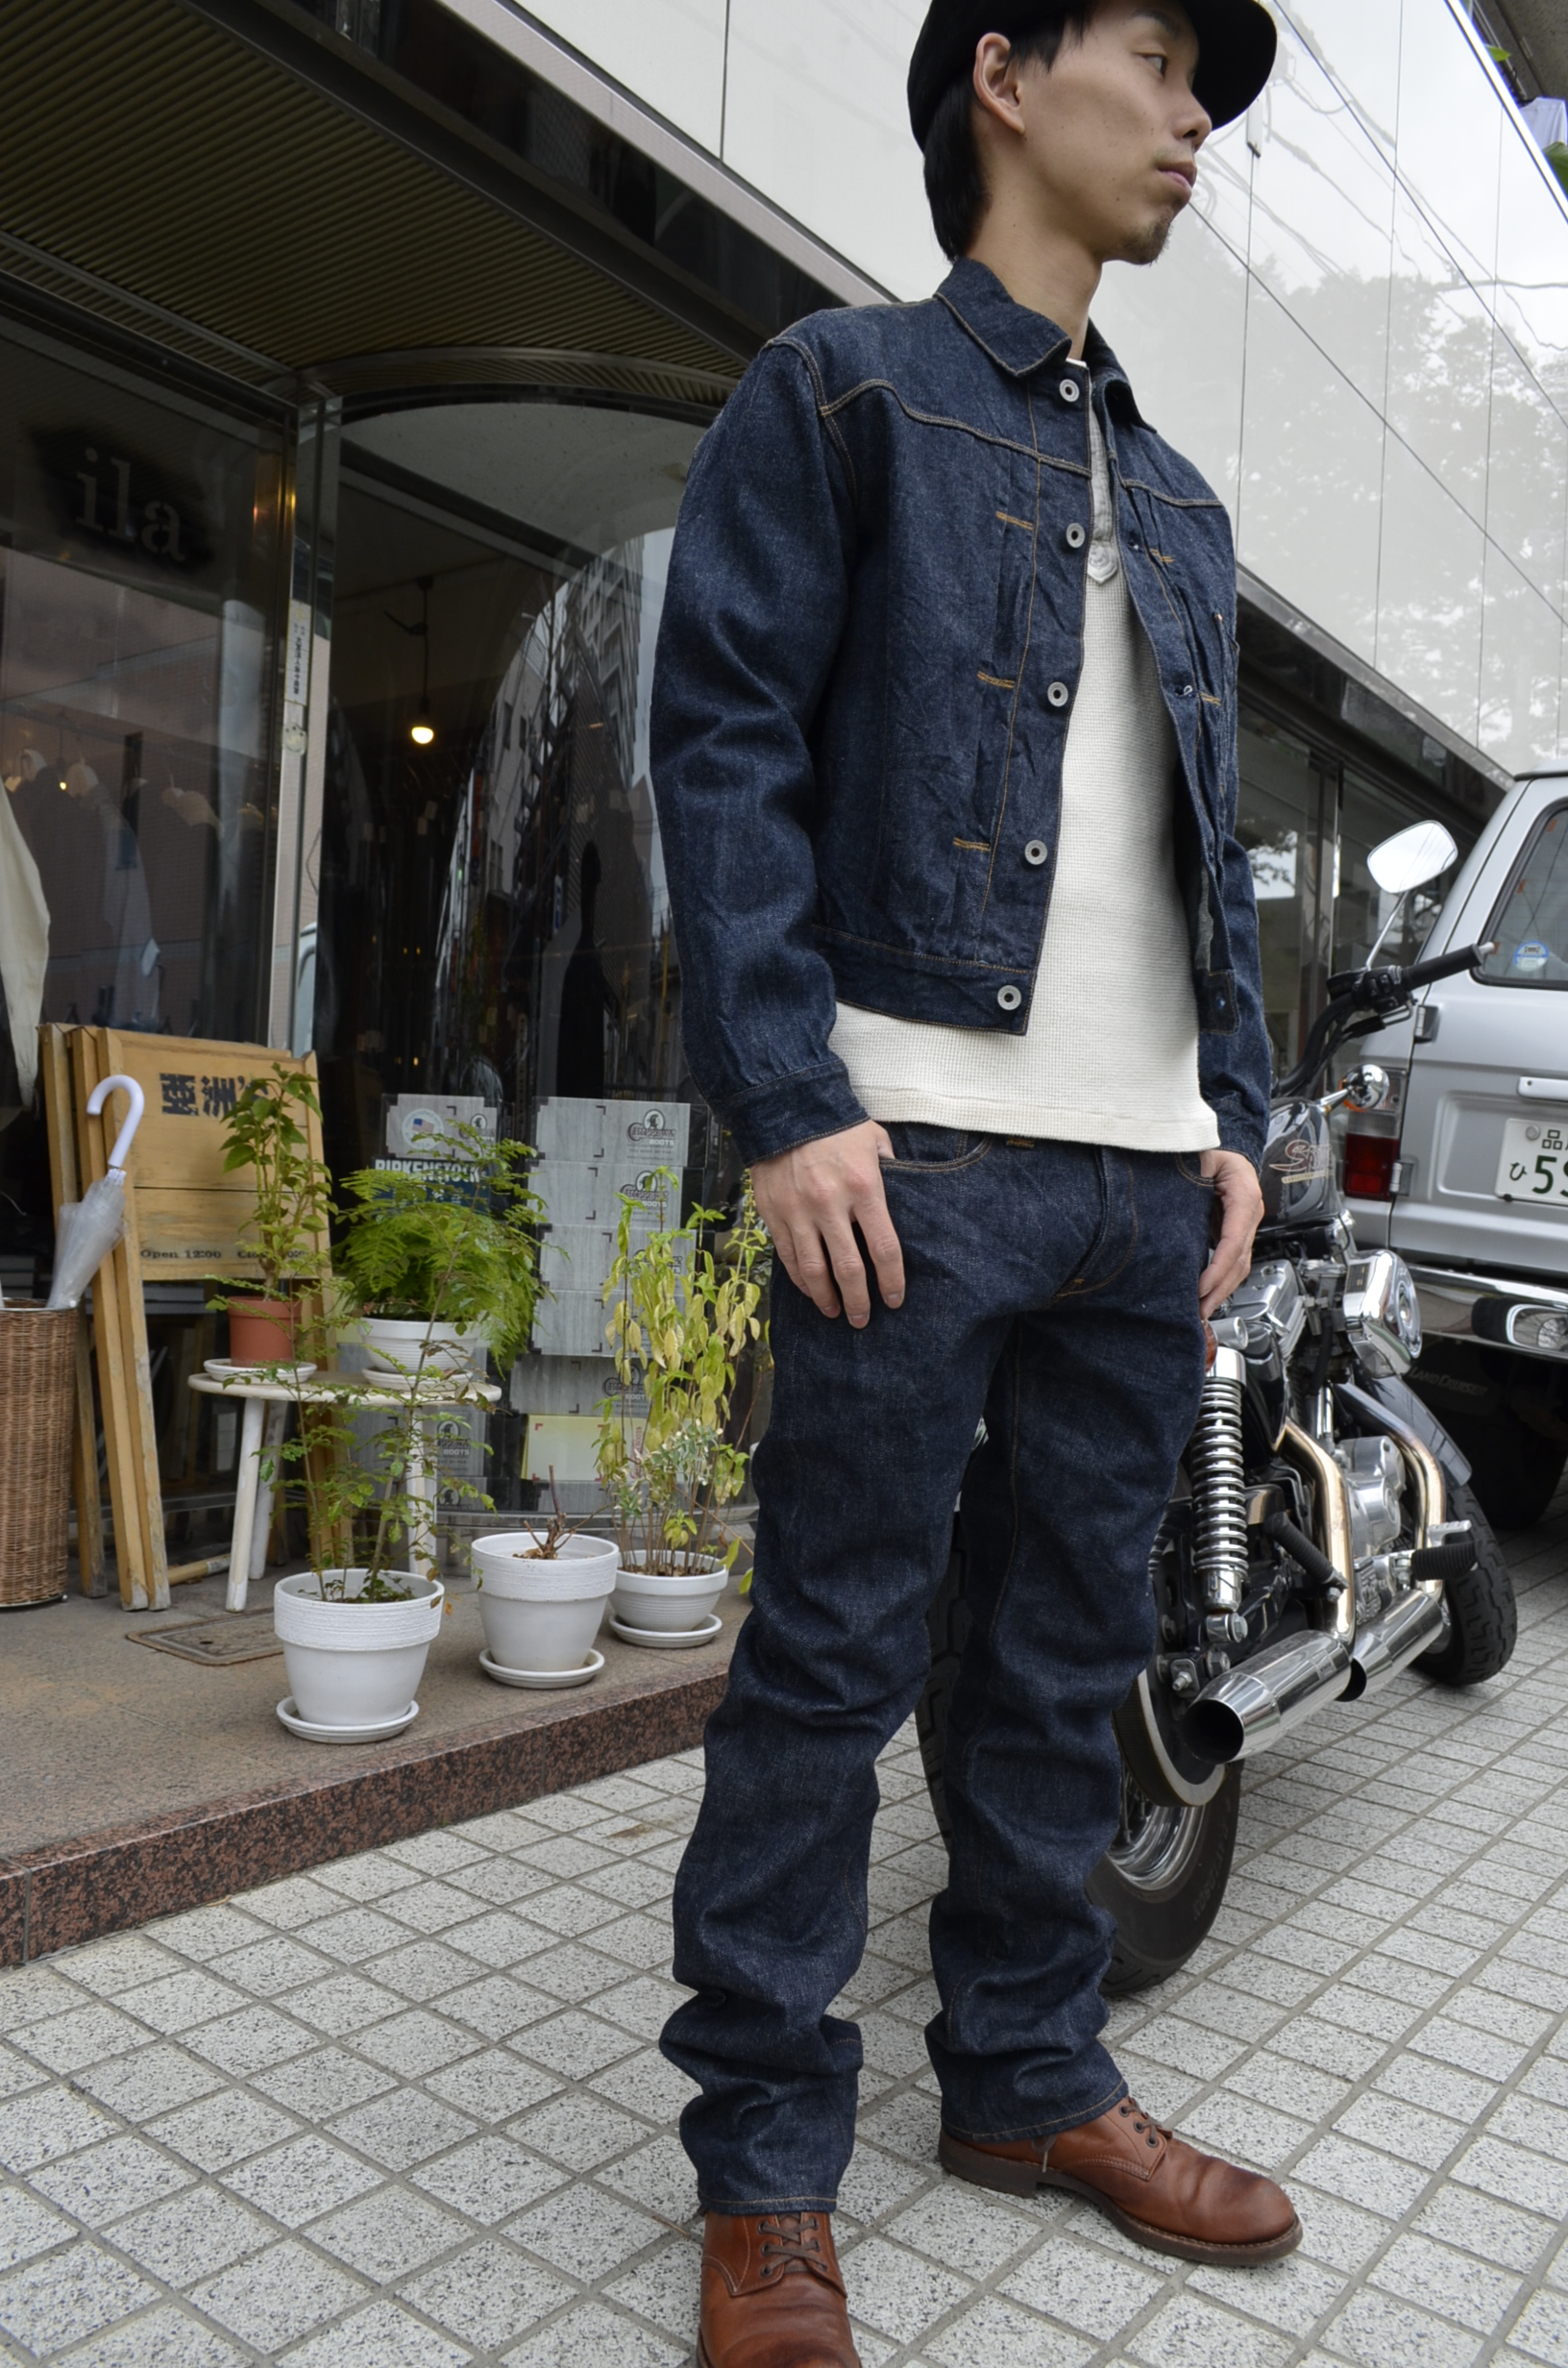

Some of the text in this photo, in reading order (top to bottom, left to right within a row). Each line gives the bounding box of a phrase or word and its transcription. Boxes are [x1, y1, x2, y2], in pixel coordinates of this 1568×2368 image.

[75, 447, 185, 562] ila
[1541, 1129, 1568, 1150] 品
[1509, 1162, 1528, 1181] ひ
[140, 1249, 178, 1260] Open
[184, 1249, 222, 1259] 12:00
[1409, 1367, 1489, 1396] LAND CRUISER
